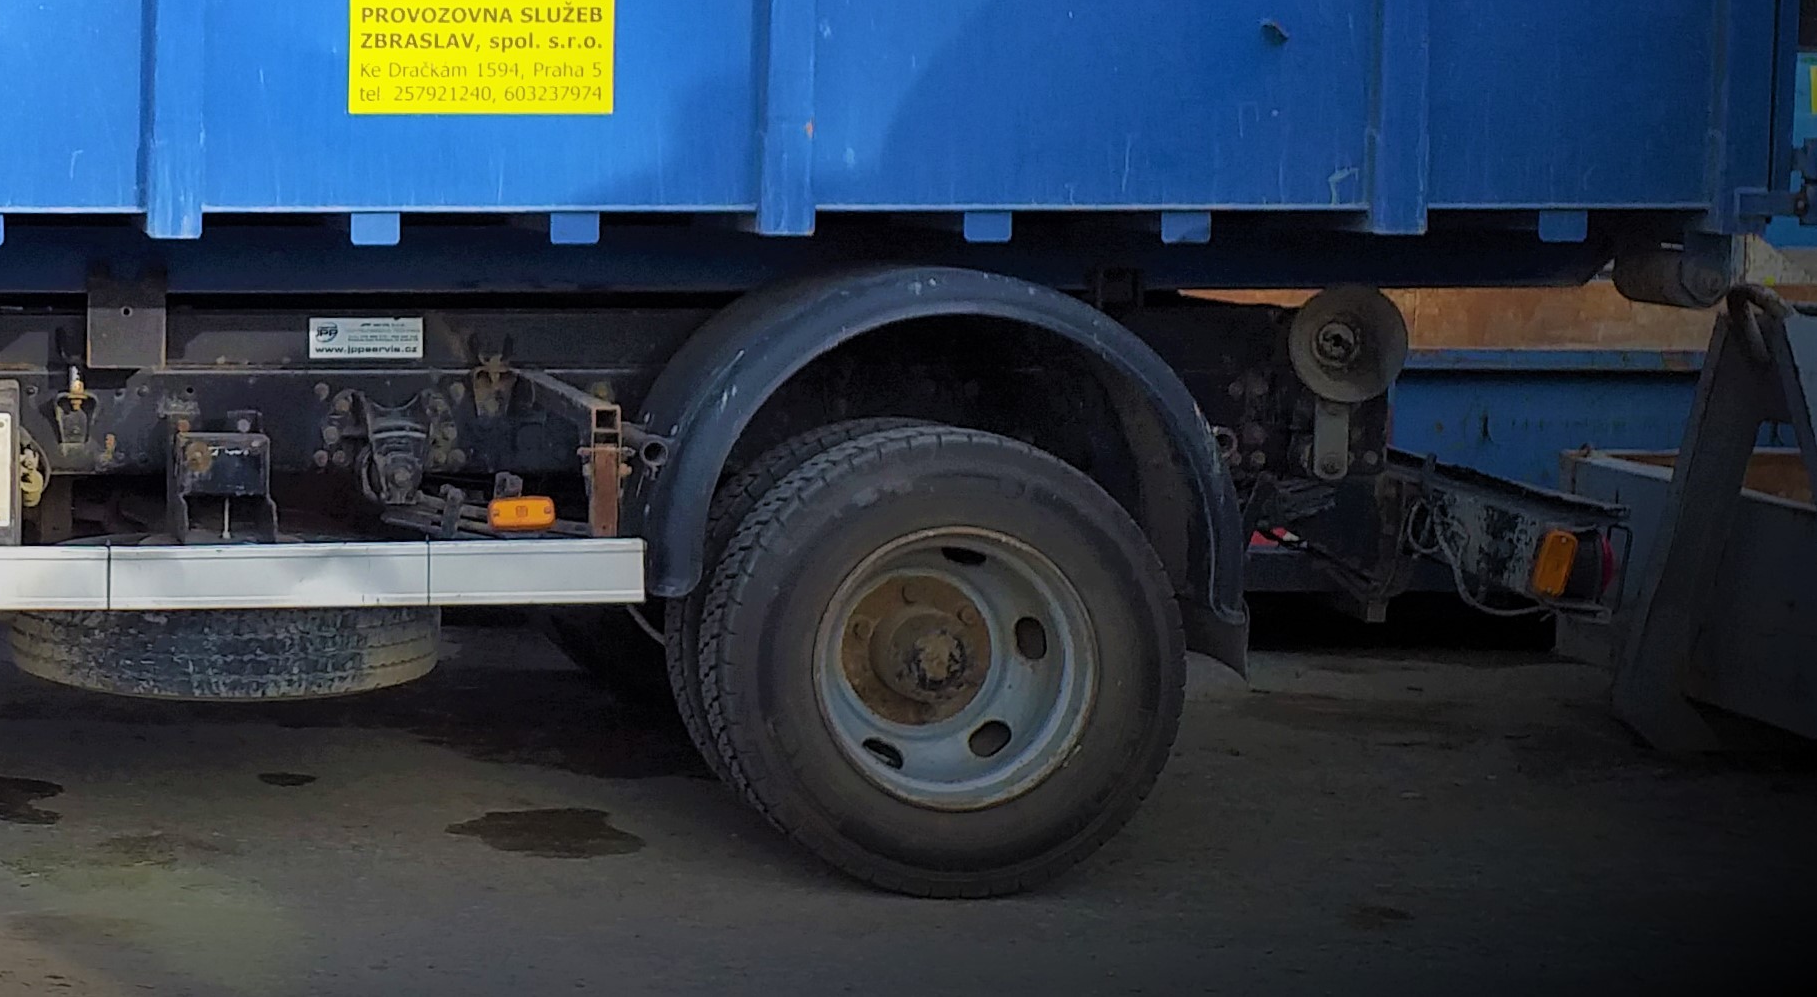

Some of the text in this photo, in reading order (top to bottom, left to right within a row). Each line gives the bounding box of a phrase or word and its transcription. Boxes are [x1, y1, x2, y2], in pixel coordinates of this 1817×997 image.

[361, 1, 603, 23] PROVOZOVNA SLUŽEB
[360, 32, 602, 52] ZBRASLAV, spol. s.r.o.
[360, 62, 602, 80] Ke Dračkám 1594, Praha 5
[393, 86, 496, 103] 257921240,
[504, 86, 602, 102] 603237974
